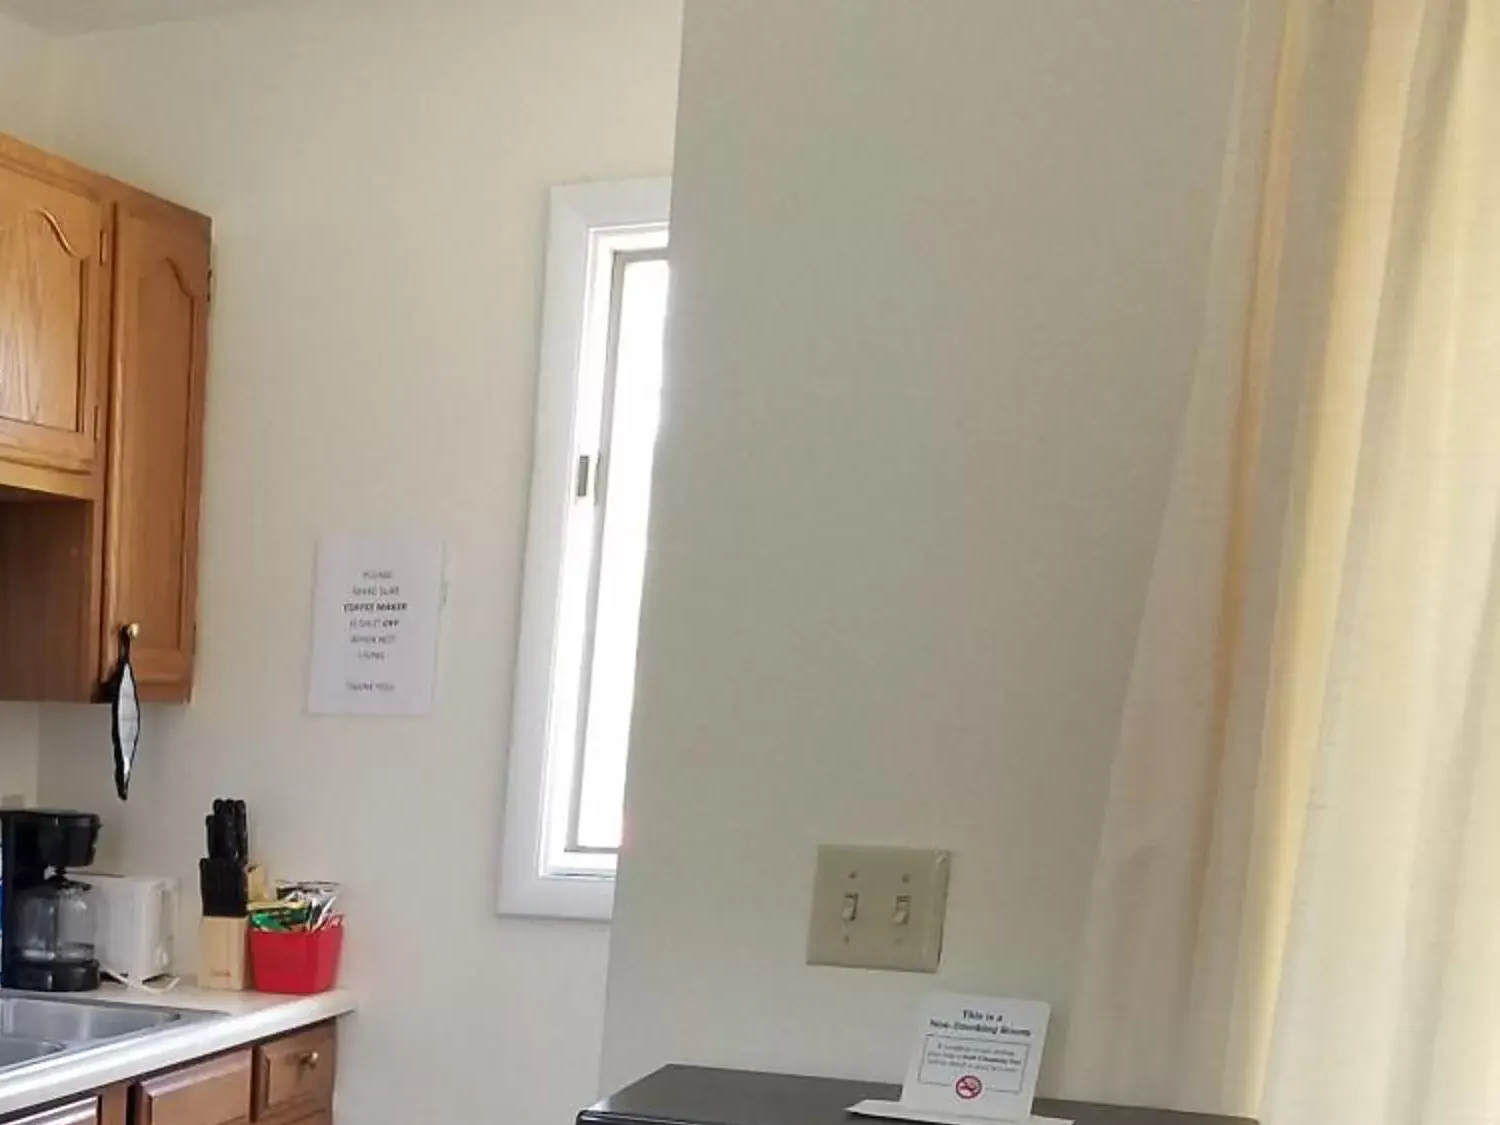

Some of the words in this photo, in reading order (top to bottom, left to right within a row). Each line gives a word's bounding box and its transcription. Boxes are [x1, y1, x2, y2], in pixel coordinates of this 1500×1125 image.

[343, 602, 374, 613] COFFEE
[376, 602, 408, 611] MAKER
[382, 619, 400, 628] OFF
[963, 1009, 983, 1020] This
[986, 1013, 995, 1021] is
[929, 1019, 999, 1035] Non-Smoking
